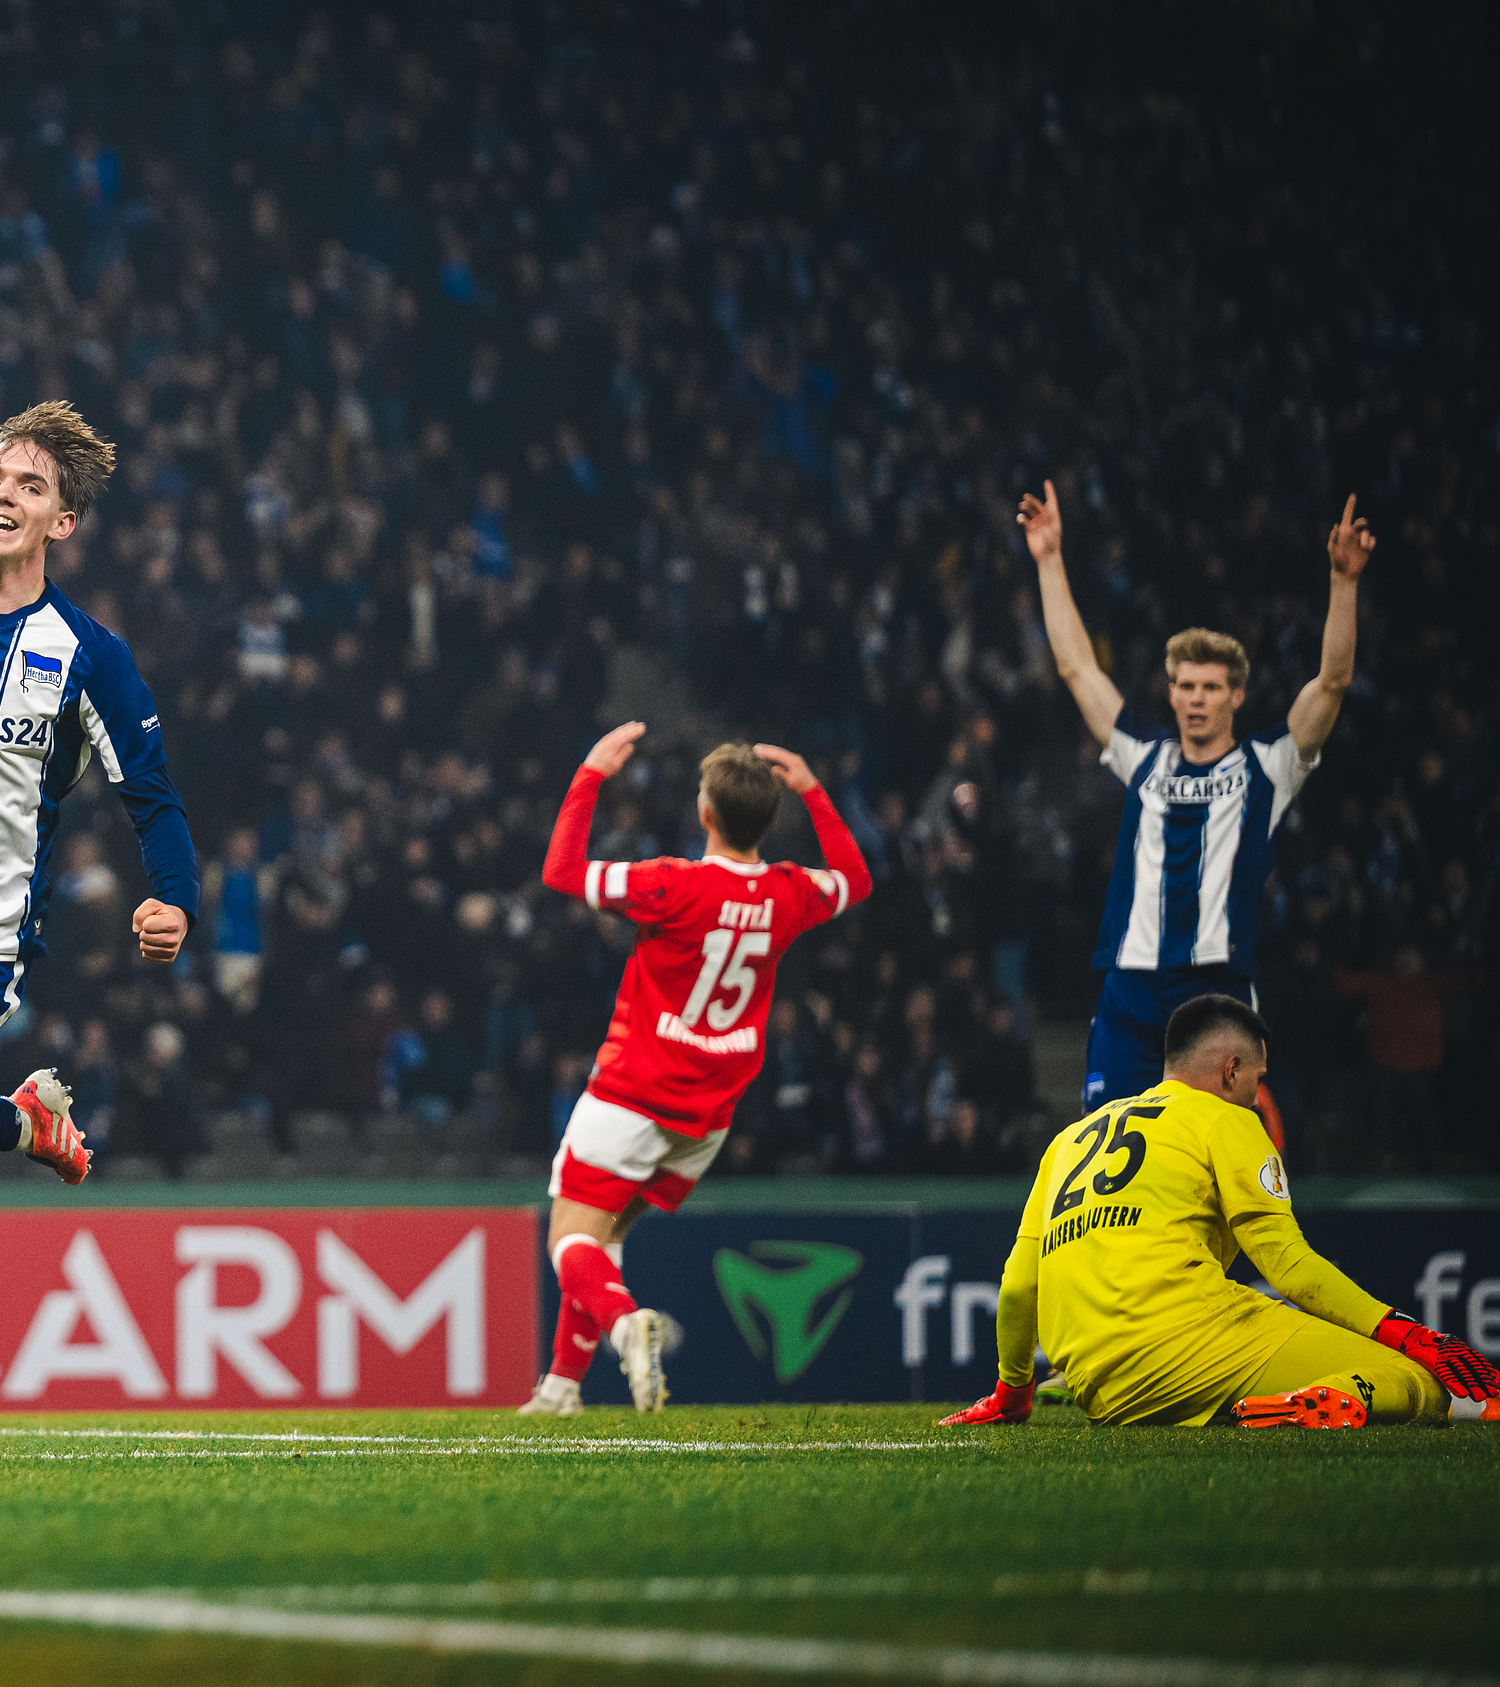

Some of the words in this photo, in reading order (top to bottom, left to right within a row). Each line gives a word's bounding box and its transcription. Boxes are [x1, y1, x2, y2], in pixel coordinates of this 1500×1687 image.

[26, 668, 48, 681] Hertha
[48, 672, 59, 684] BSC
[680, 928, 772, 1031] 15
[1050, 1106, 1166, 1221] 25
[1041, 1207, 1143, 1259] KAISERSLAUTERN
